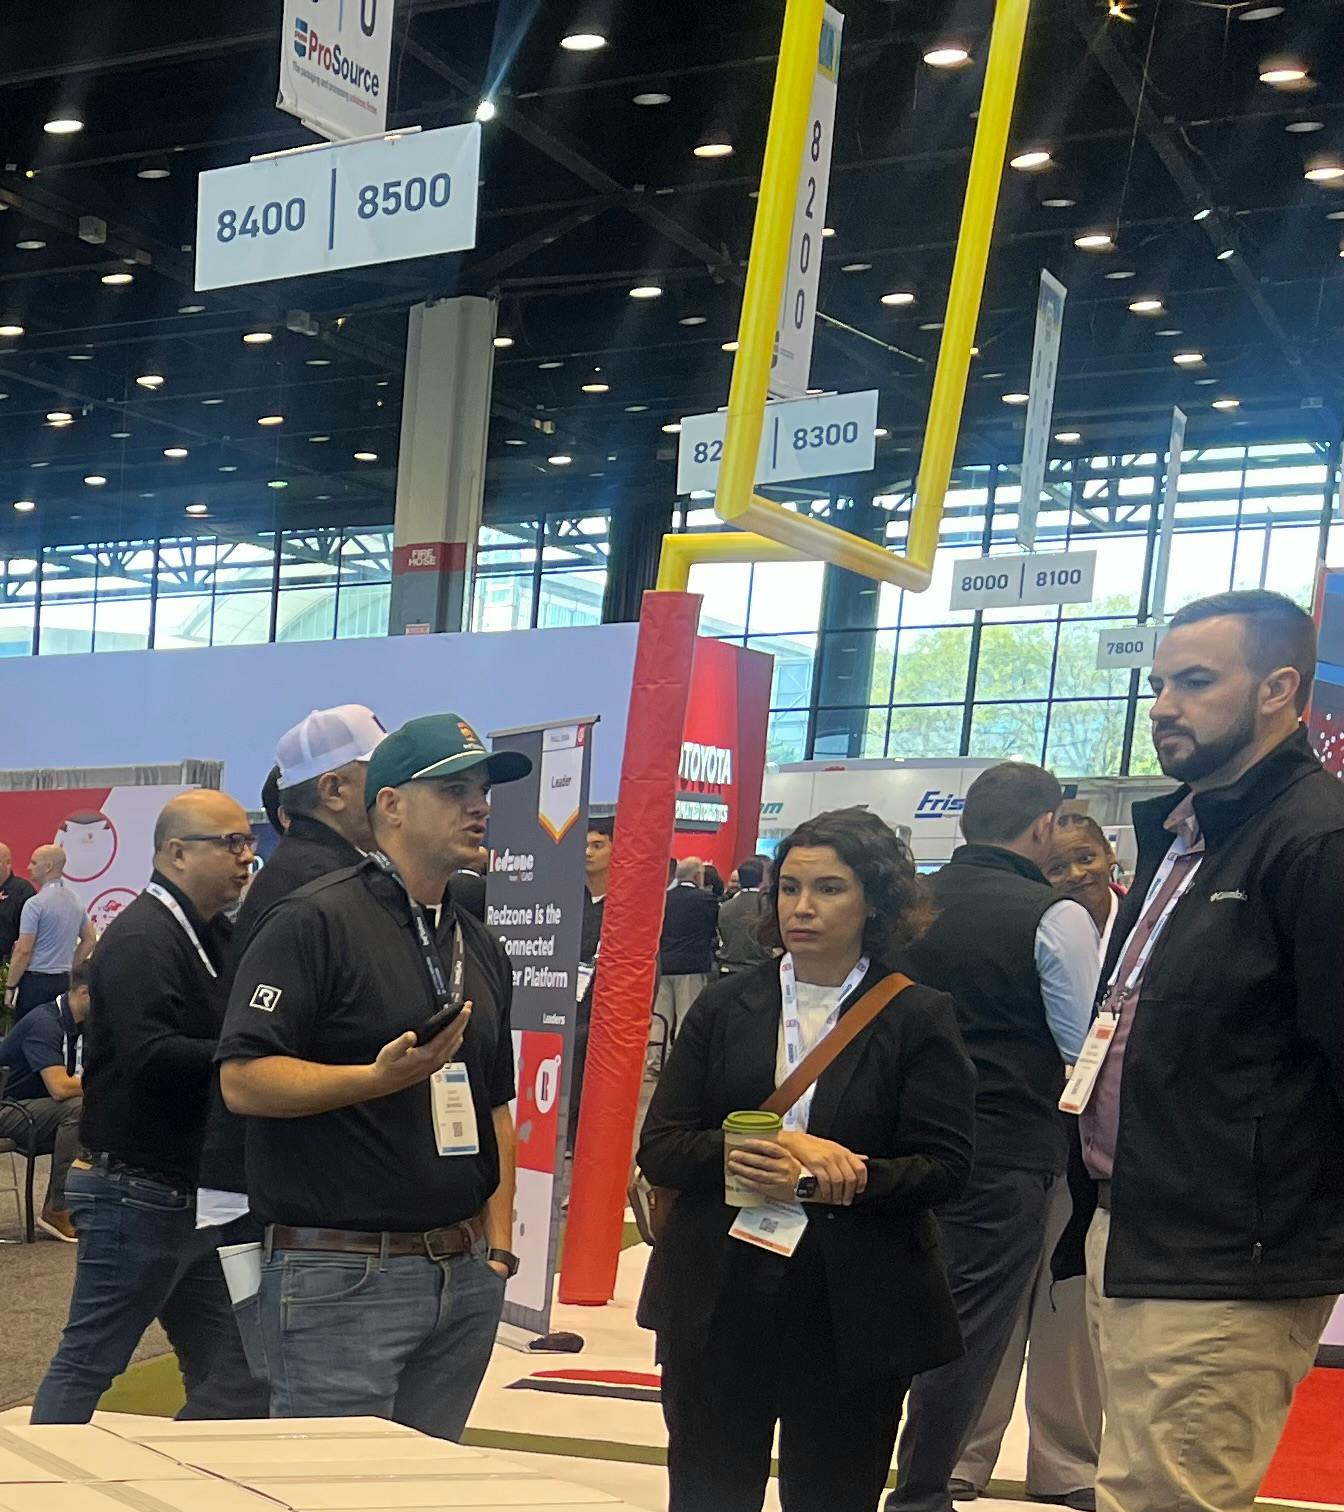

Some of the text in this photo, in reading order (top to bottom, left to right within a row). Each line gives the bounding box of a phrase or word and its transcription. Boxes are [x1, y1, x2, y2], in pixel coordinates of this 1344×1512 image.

[308, 29, 379, 96] ProSource
[216, 172, 452, 243] 8400 8500
[693, 421, 858, 464] 82 8300
[961, 568, 1081, 592] 8000 8100
[1106, 640, 1144, 655] 7800
[683, 741, 732, 785] TOYOTA
[486, 903, 562, 926] Redzone is the
[523, 966, 568, 989] Platform
